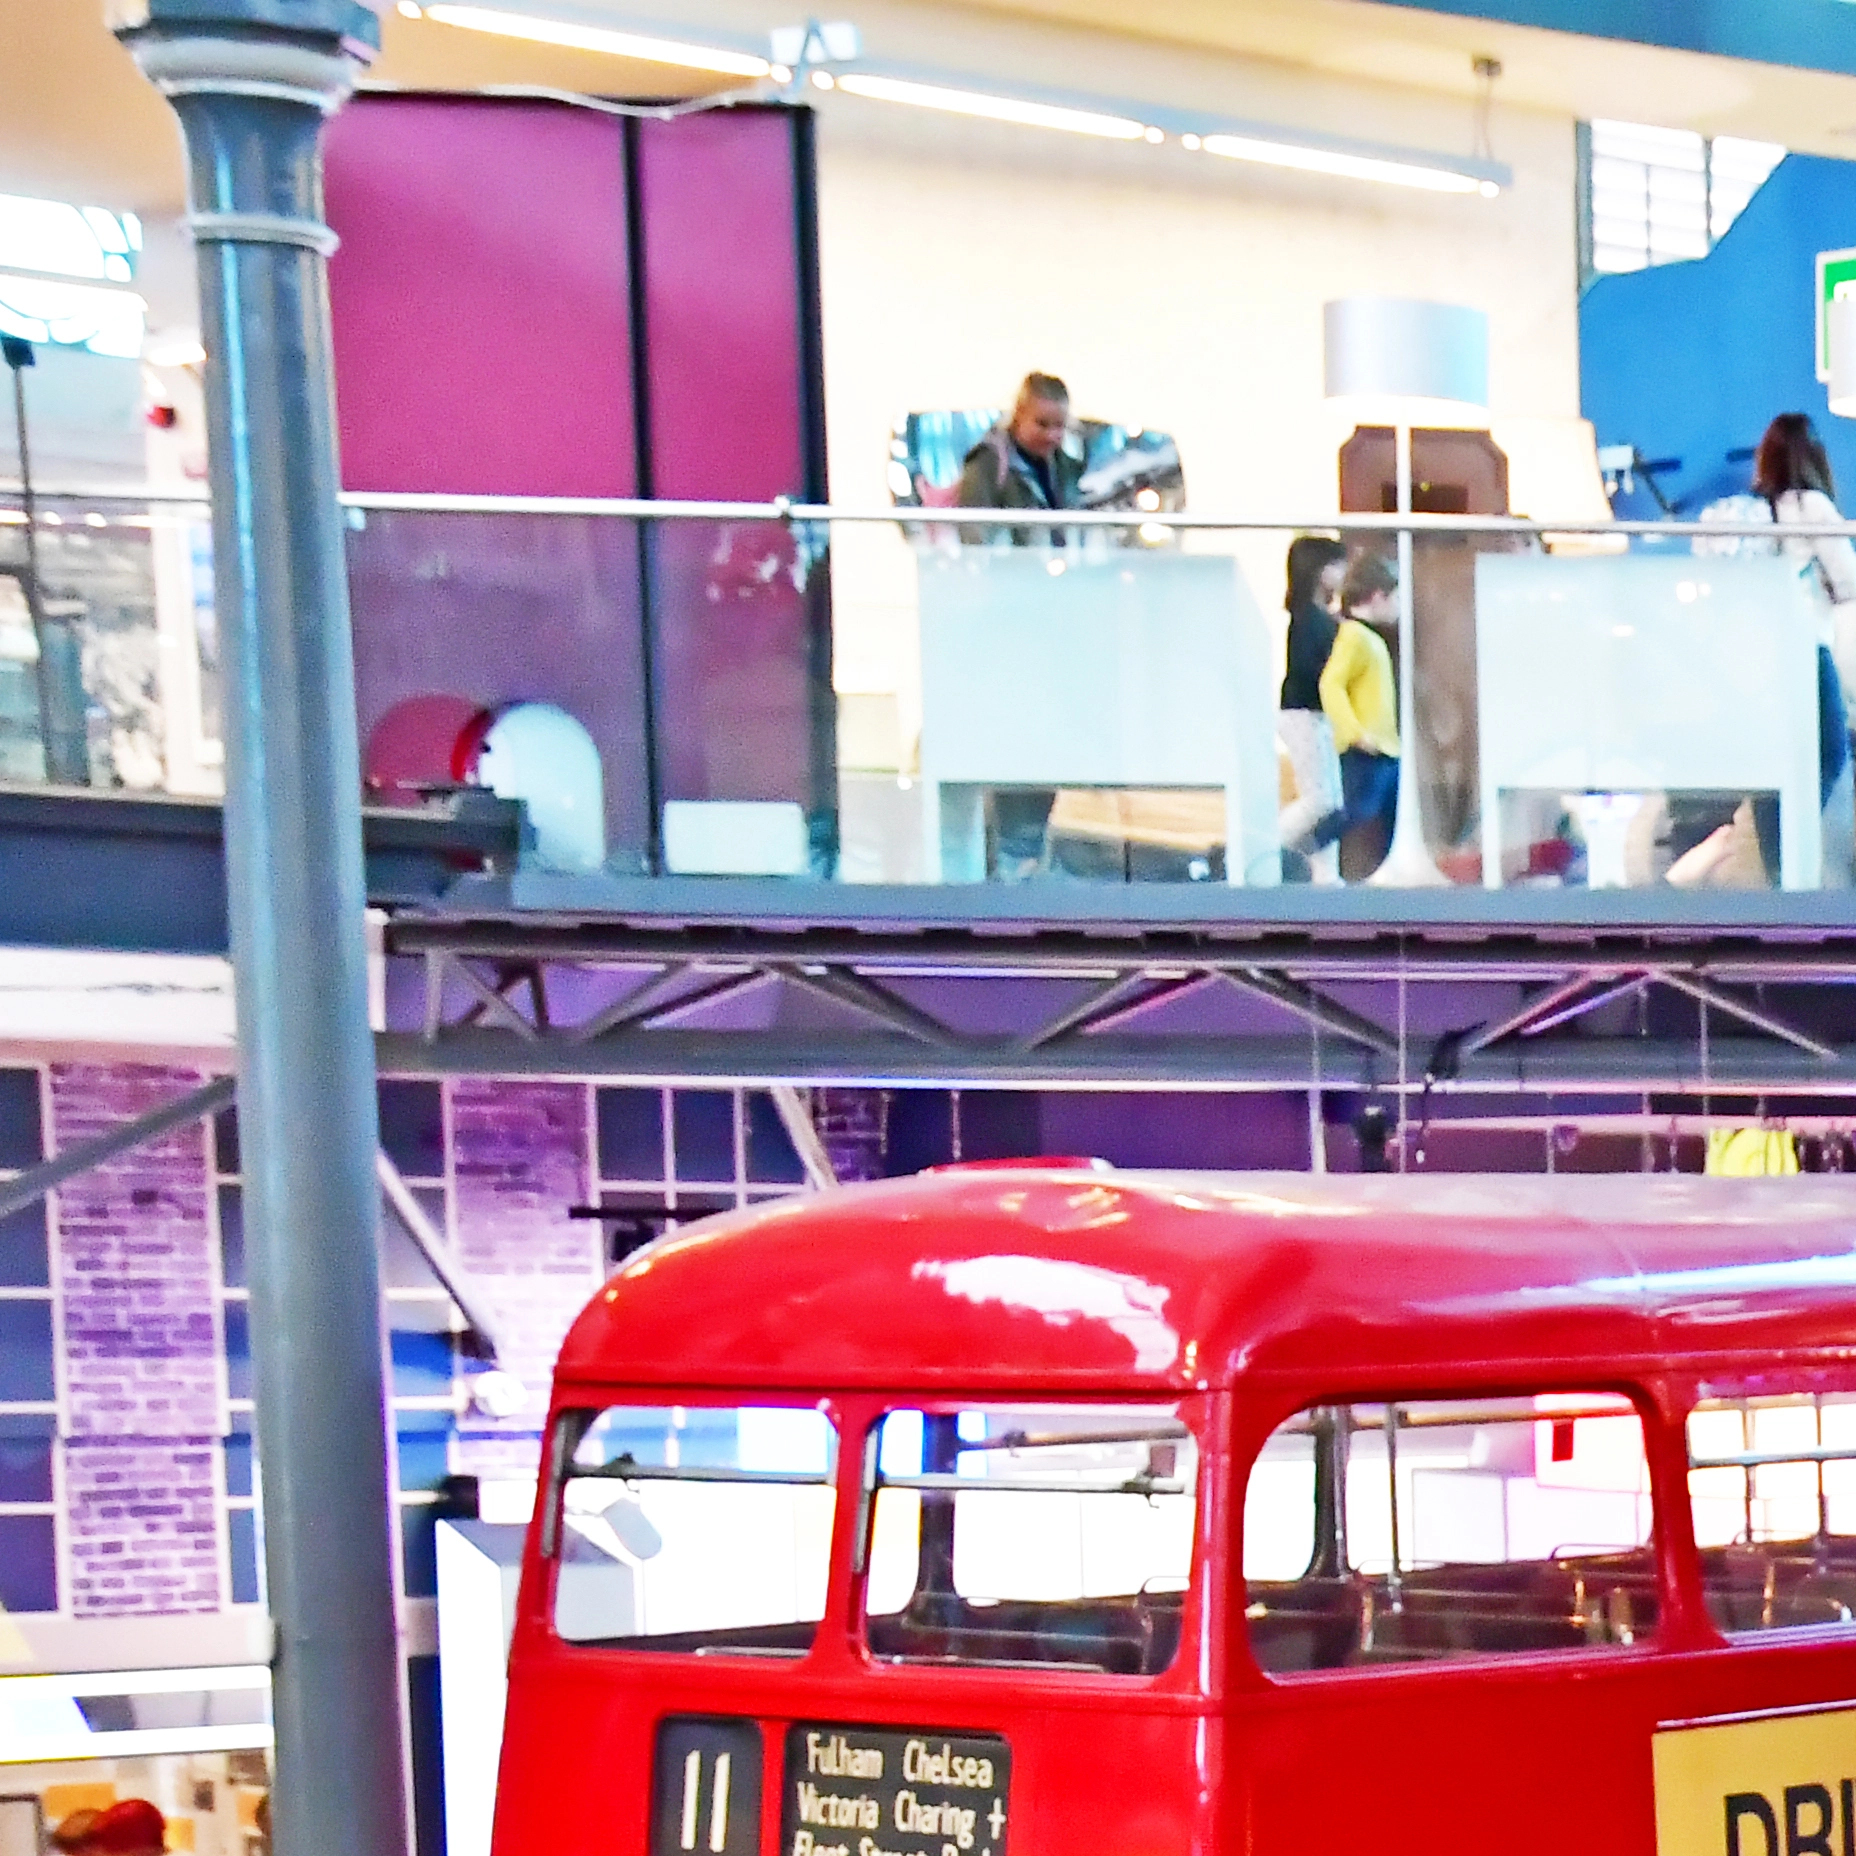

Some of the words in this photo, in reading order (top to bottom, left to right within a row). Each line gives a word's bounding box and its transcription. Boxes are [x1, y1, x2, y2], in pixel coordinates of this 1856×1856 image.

[805, 1732, 885, 1780] Fulham
[902, 1738, 994, 1789] Chelsea
[679, 1749, 731, 1853] 11
[796, 1780, 880, 1830] Victoria
[894, 1789, 976, 1850] Charing
